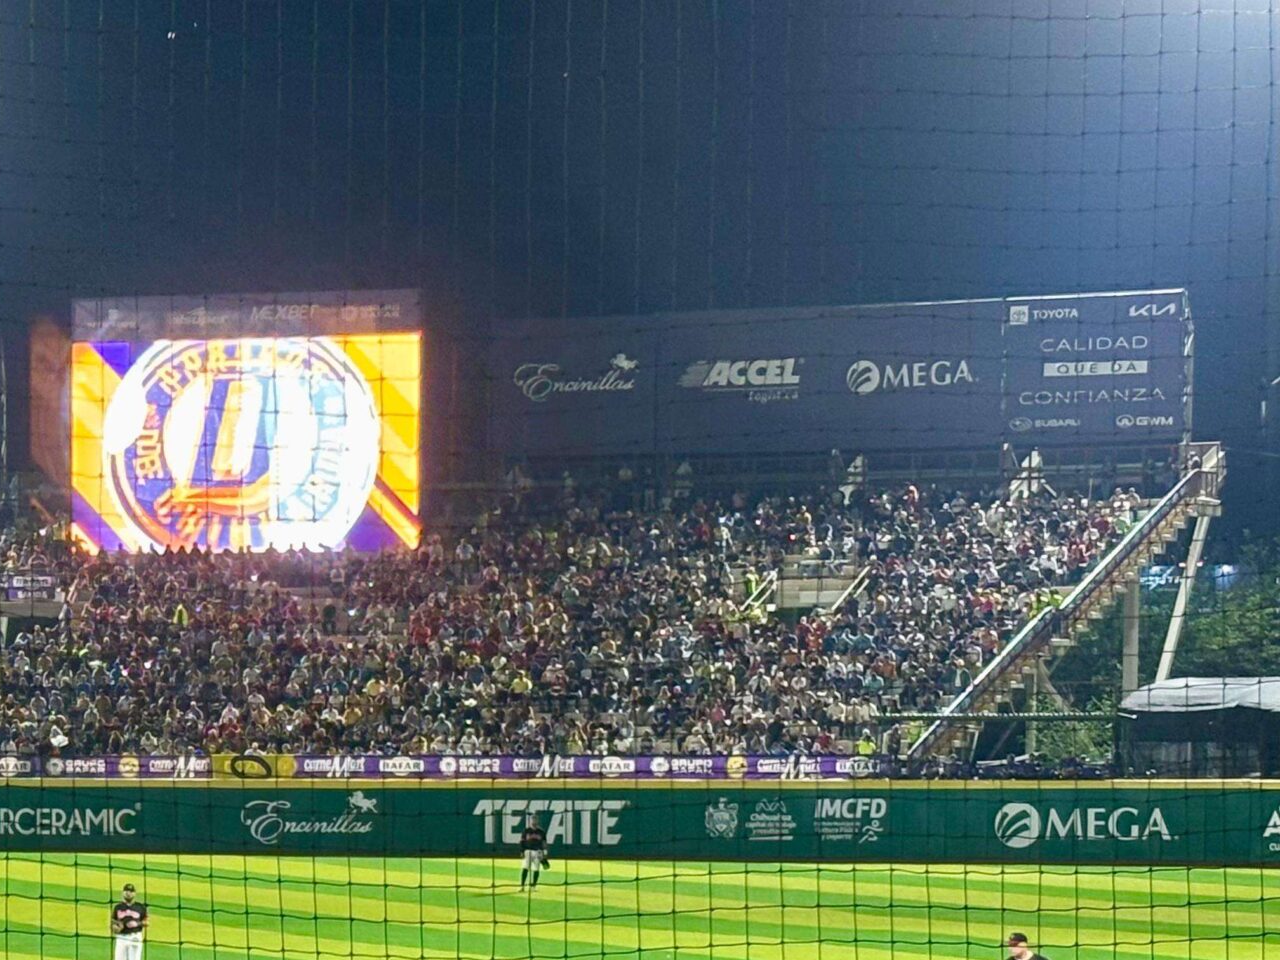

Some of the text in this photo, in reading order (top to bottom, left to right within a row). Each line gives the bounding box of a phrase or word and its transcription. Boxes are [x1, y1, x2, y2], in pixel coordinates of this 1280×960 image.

[1033, 308, 1079, 319] TOYOTA
[1040, 335, 1148, 352] CALIDAD
[702, 358, 800, 386] ACCEL
[883, 360, 974, 389] MEGA
[1057, 361, 1138, 375] QUE DA
[514, 363, 635, 402] Encinillas
[1019, 387, 1166, 405] CONFIANZA
[1136, 416, 1173, 426] GWM
[814, 798, 886, 818] IMCFD
[241, 800, 373, 844] Encinillas
[1045, 807, 1171, 840] MEGA
